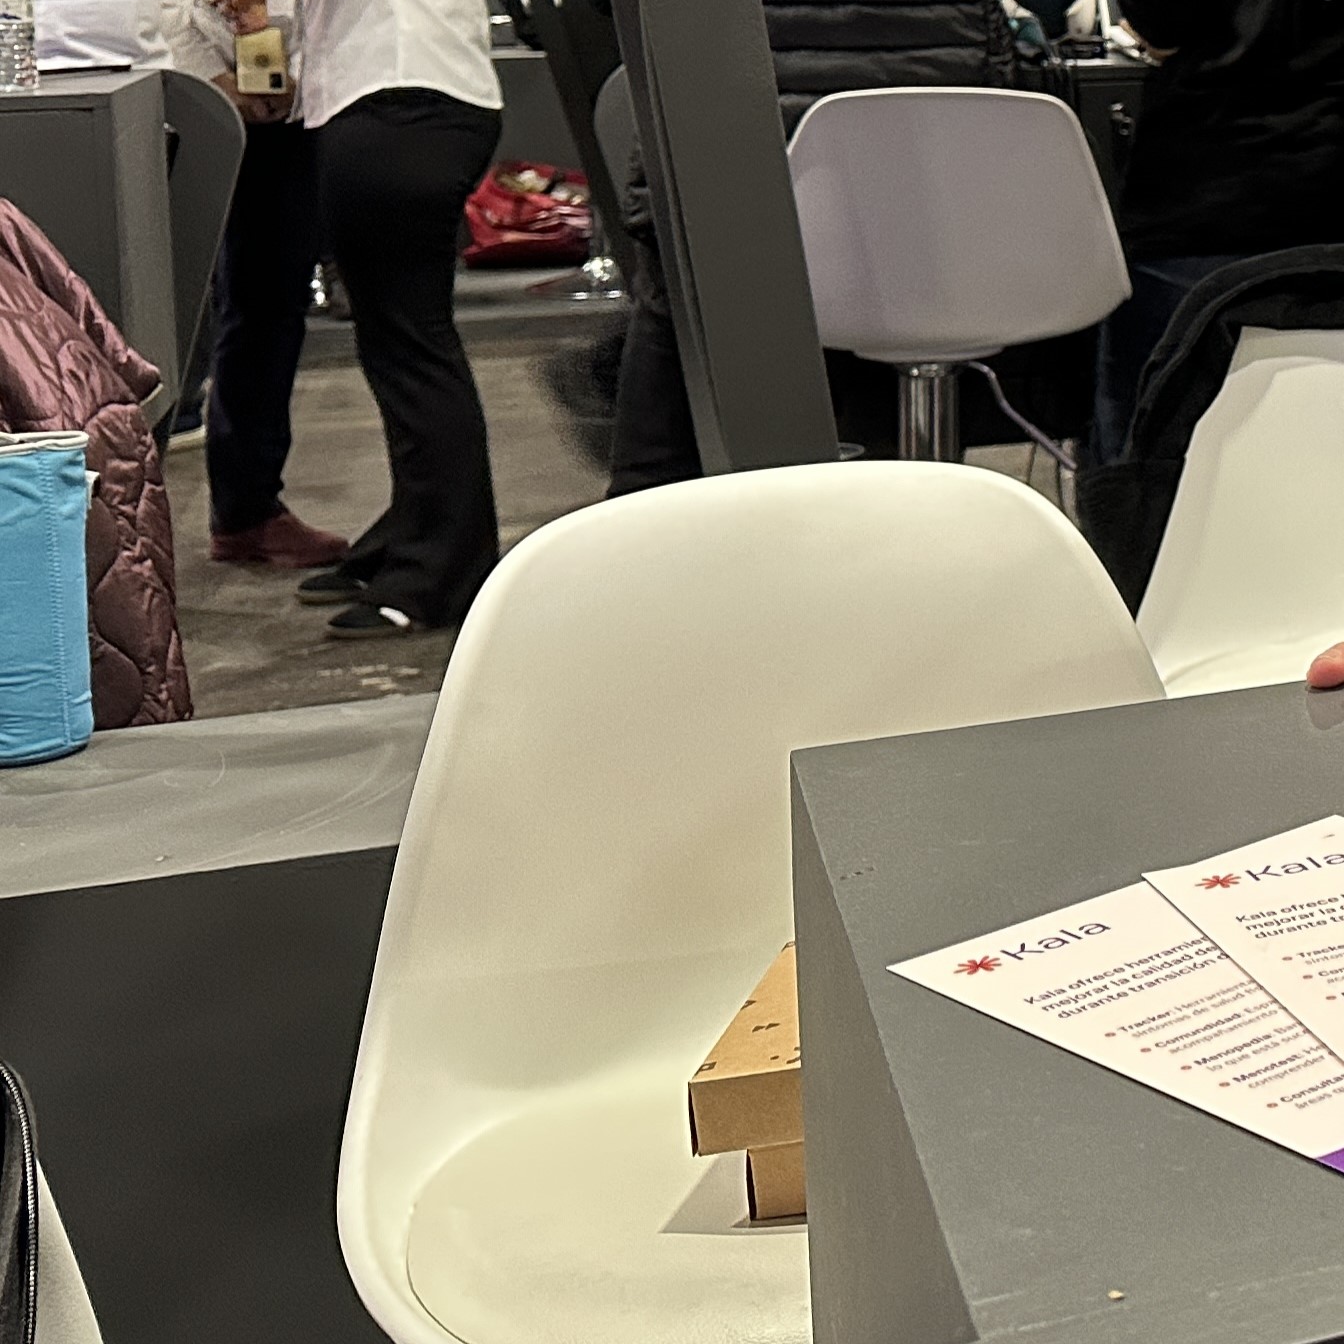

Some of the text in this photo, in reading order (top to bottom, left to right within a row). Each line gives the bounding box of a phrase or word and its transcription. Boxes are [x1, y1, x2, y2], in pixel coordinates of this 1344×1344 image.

[1235, 911, 1277, 922] Kala
[1280, 897, 1338, 912] ofrece
[1245, 912, 1314, 930] mejorar
[1255, 920, 1327, 938] durante
[1000, 922, 1111, 961] Kala
